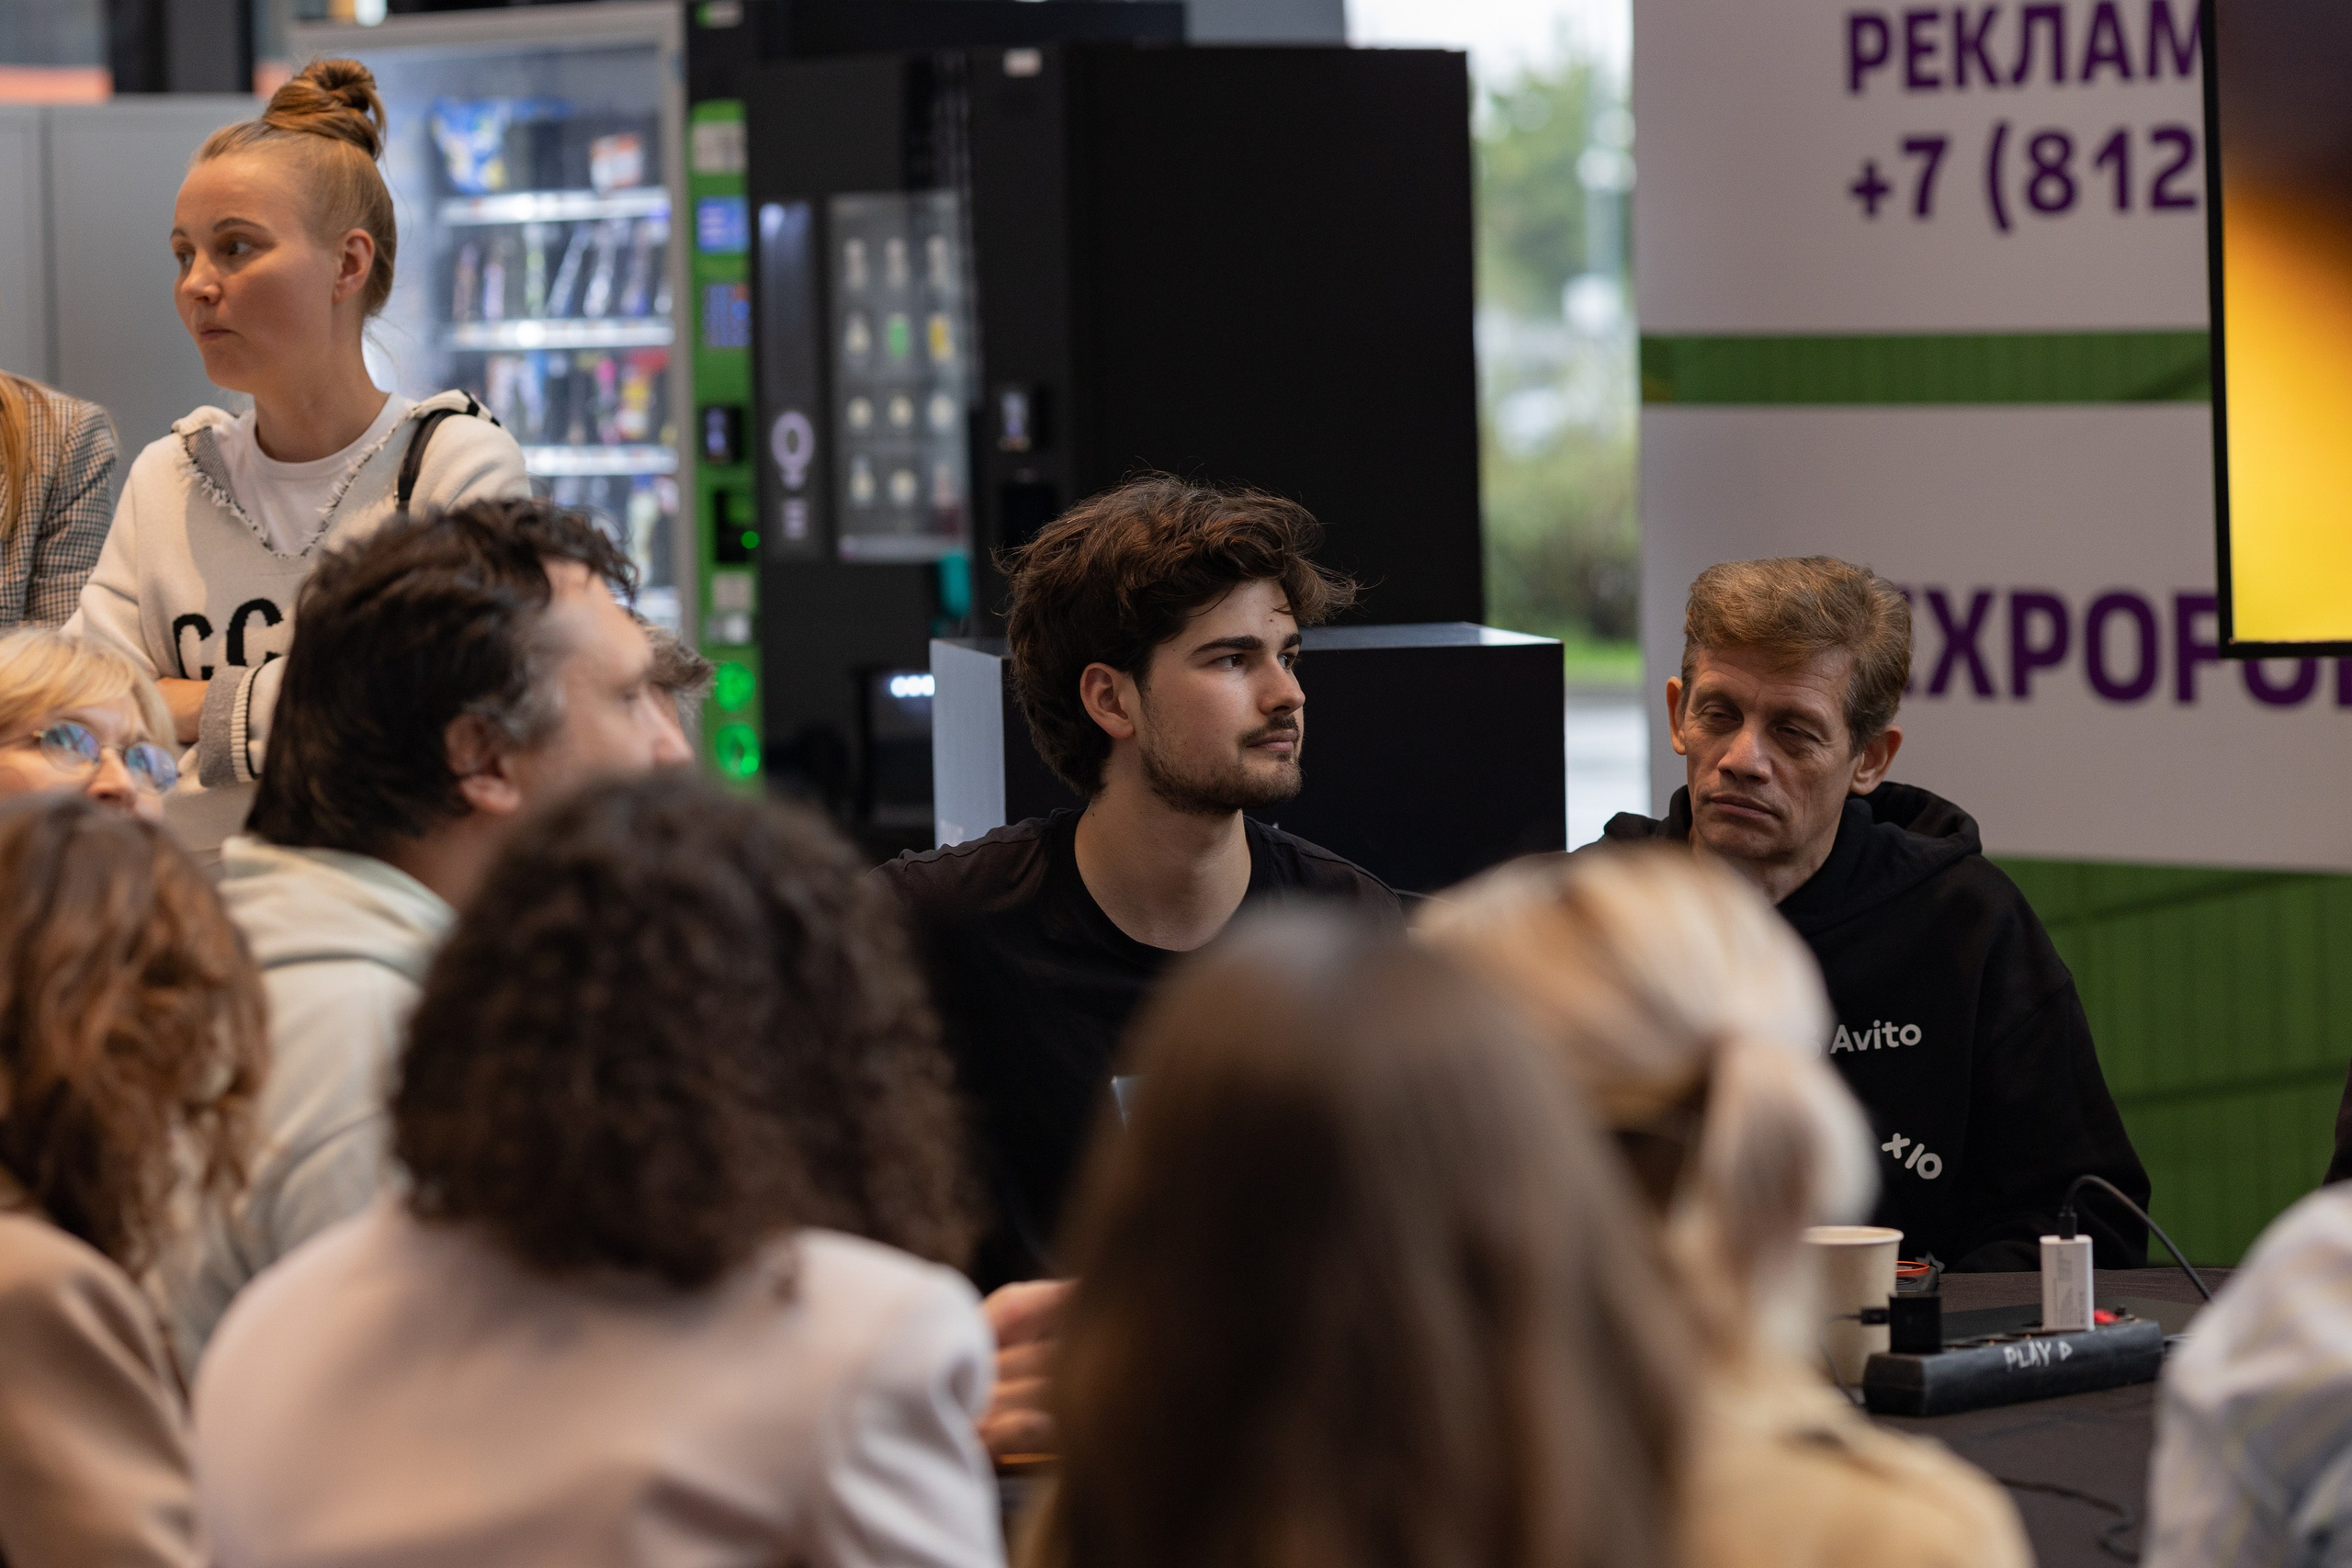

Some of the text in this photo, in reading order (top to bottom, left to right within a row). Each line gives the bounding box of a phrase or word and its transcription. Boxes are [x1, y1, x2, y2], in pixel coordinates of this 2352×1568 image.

[1849, 122, 2199, 233] +7 (812
[1900, 589, 2352, 707] XPOF
[1830, 1020, 1922, 1055] Avito
[2003, 1340, 2052, 1372] PLAY
